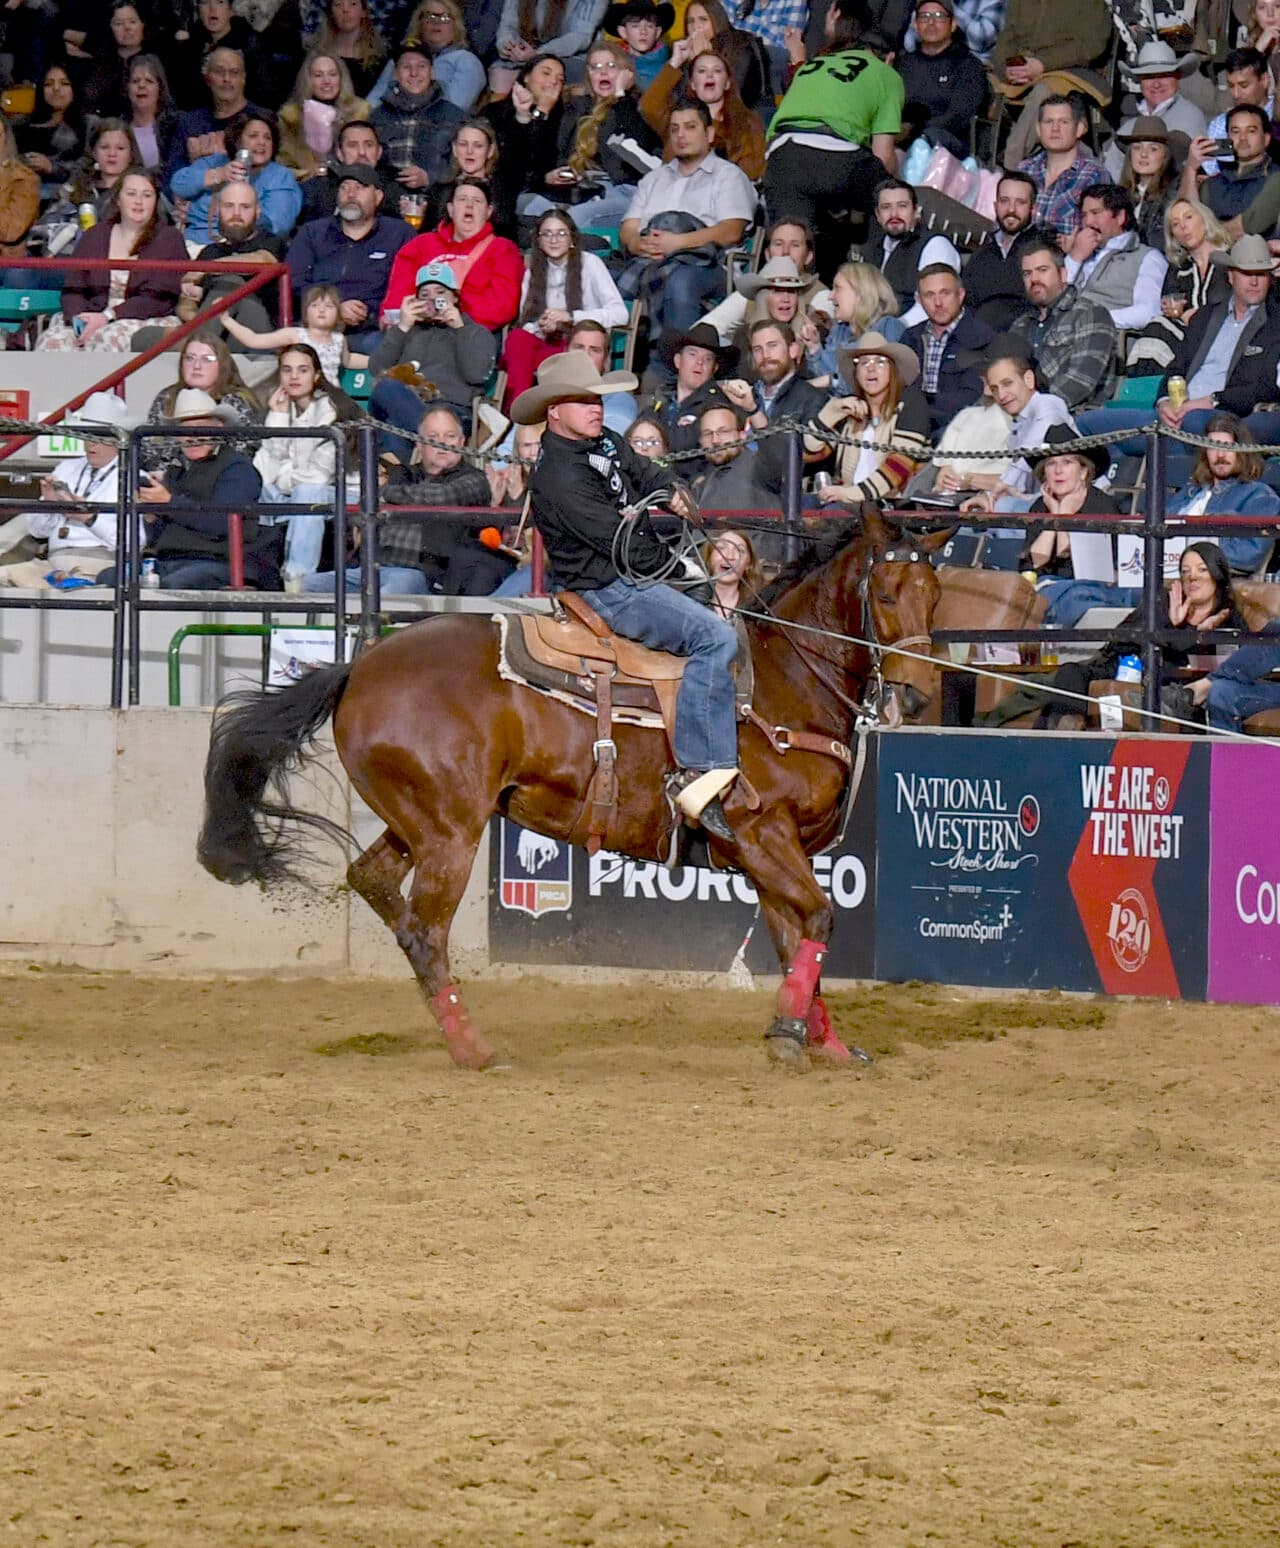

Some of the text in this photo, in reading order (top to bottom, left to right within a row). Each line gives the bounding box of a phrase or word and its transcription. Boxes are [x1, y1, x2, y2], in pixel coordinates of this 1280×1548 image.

[19, 297, 30, 311] 5
[353, 373, 365, 388] 9
[1107, 463, 1118, 479] 6
[943, 541, 954, 557] 6
[894, 772, 1008, 813] NATIONAL
[1080, 764, 1154, 810] WE ARE
[912, 811, 1020, 851] WESTERN
[1090, 811, 1184, 859] THE WEST
[938, 847, 1030, 872] Stock Show
[920, 917, 1004, 944] CommonSpirit
[1106, 902, 1151, 954] 120
